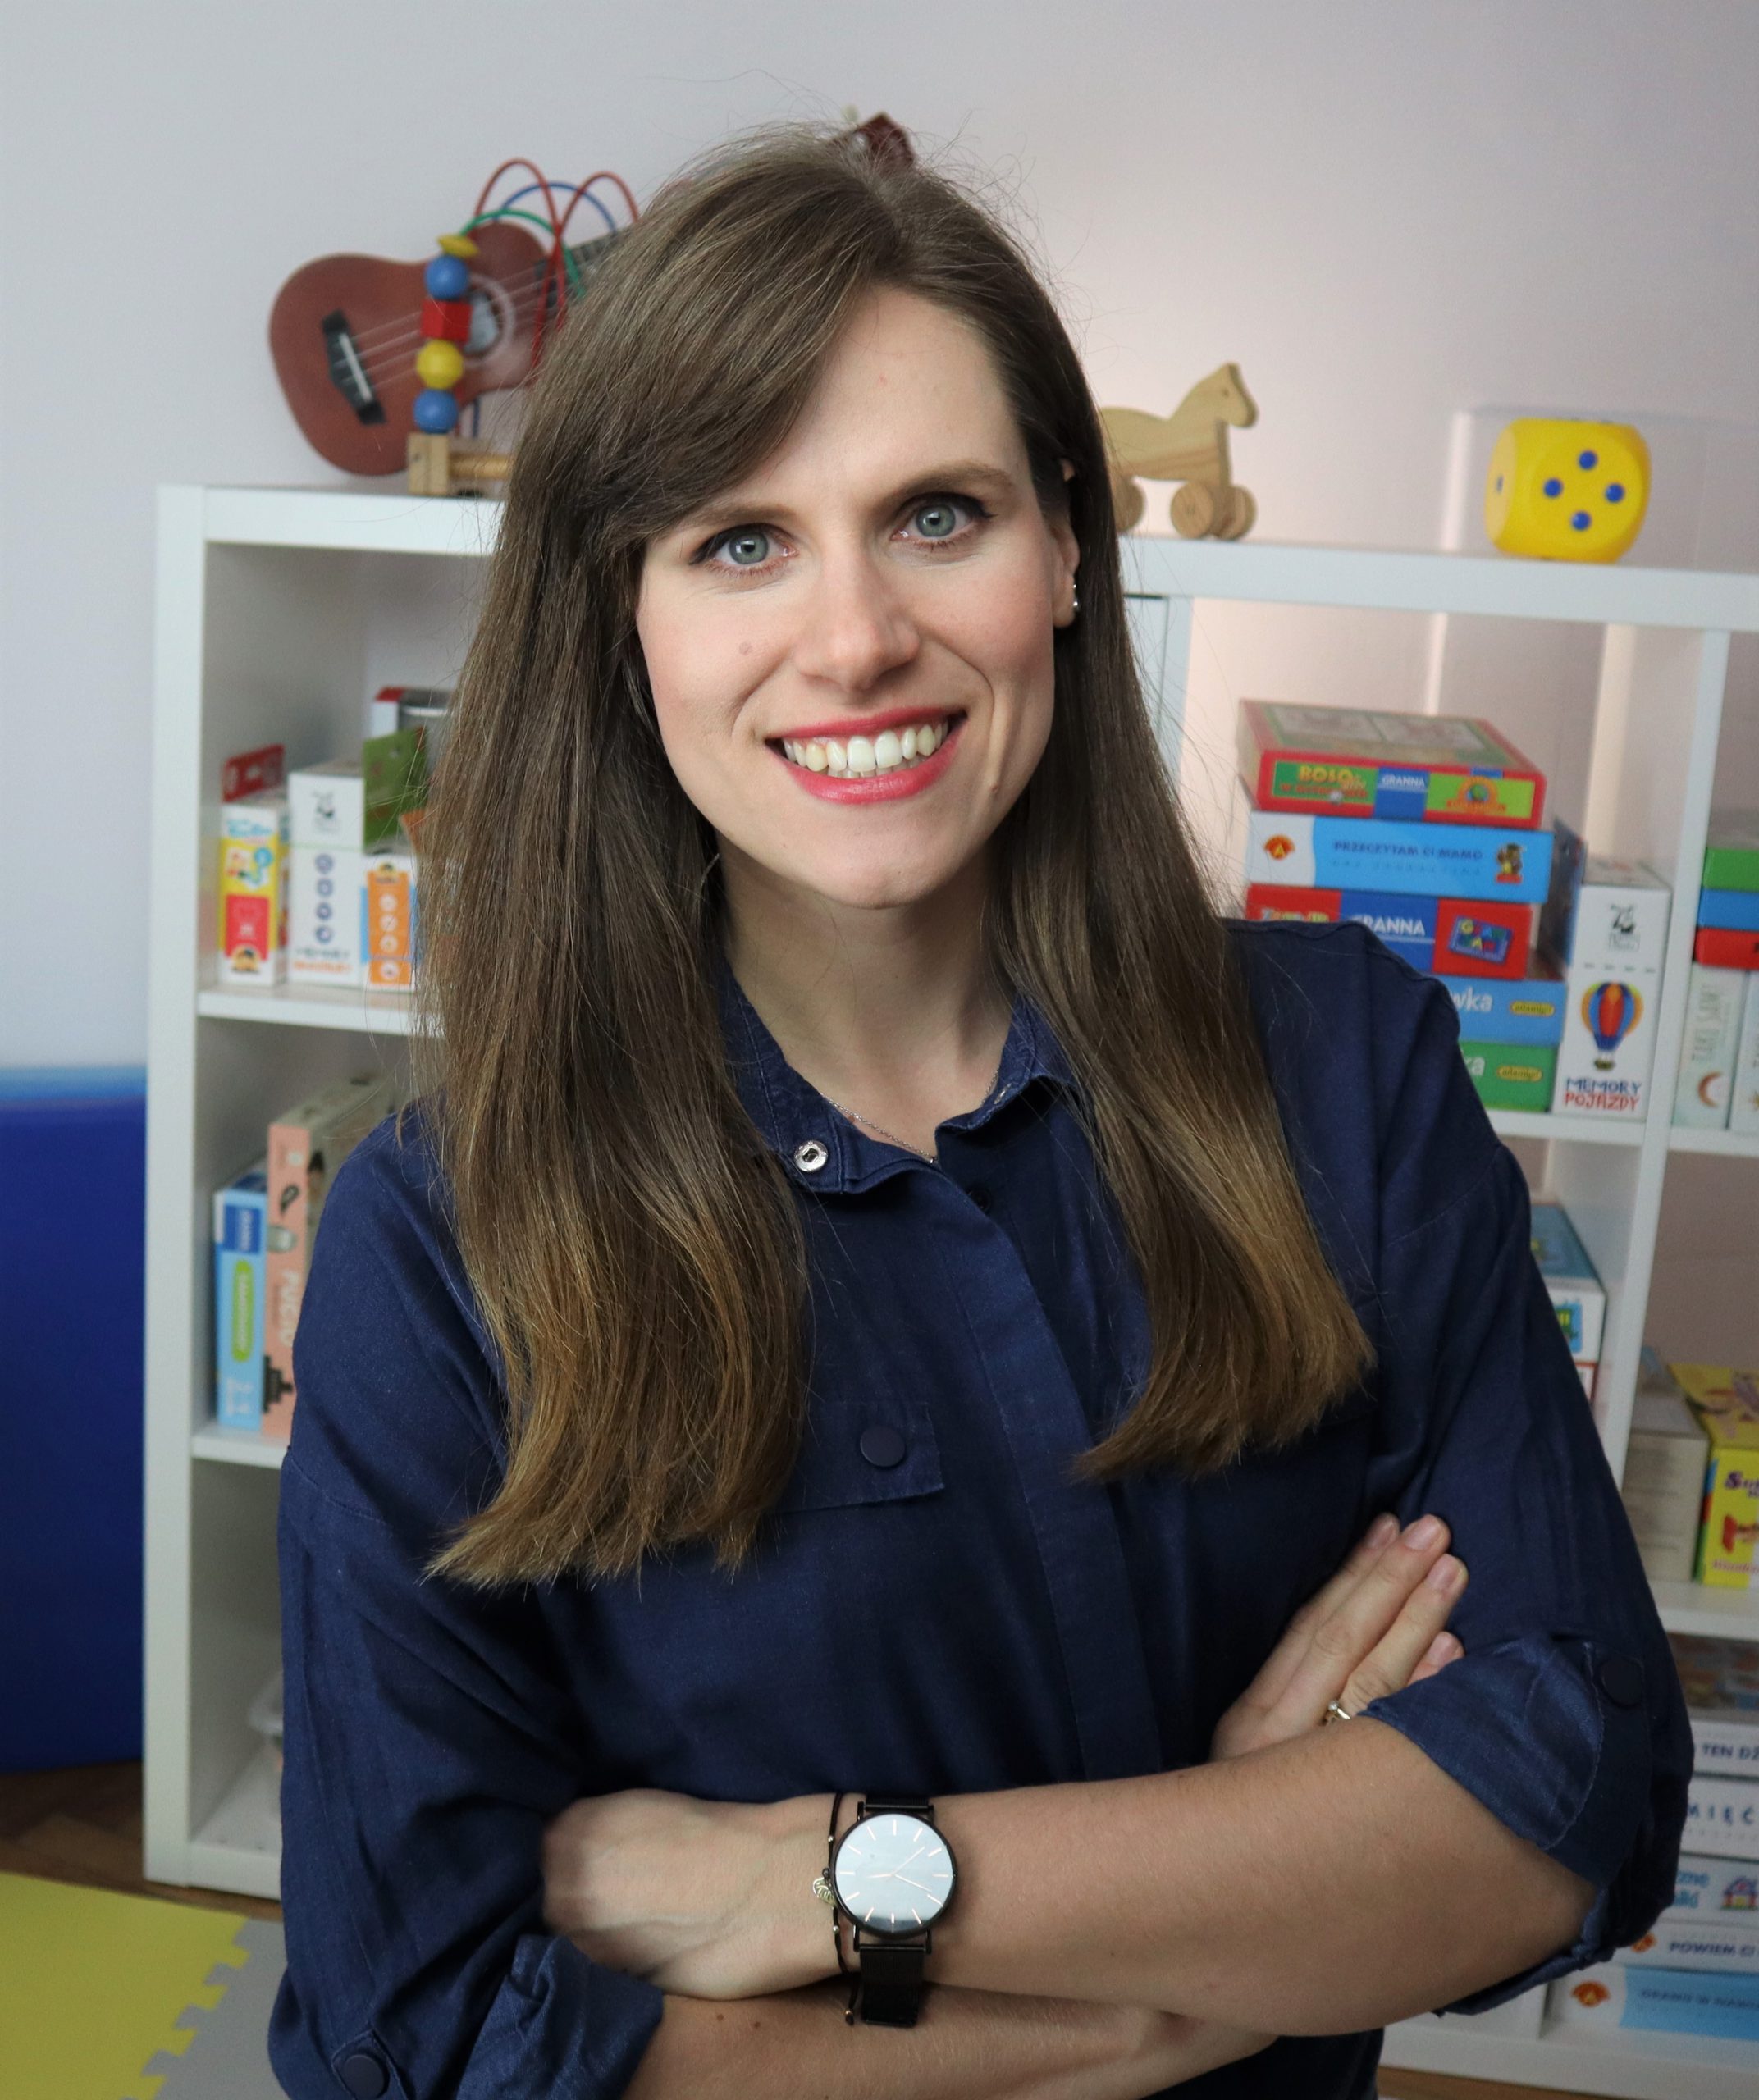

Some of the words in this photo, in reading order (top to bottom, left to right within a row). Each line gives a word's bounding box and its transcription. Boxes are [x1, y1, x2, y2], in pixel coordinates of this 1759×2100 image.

[1381, 774, 1426, 788] GRANNA
[1565, 1077, 1642, 1095] MEMORY
[1702, 1742, 1734, 1757] TEN
[1670, 1940, 1736, 1956] POWIEM
